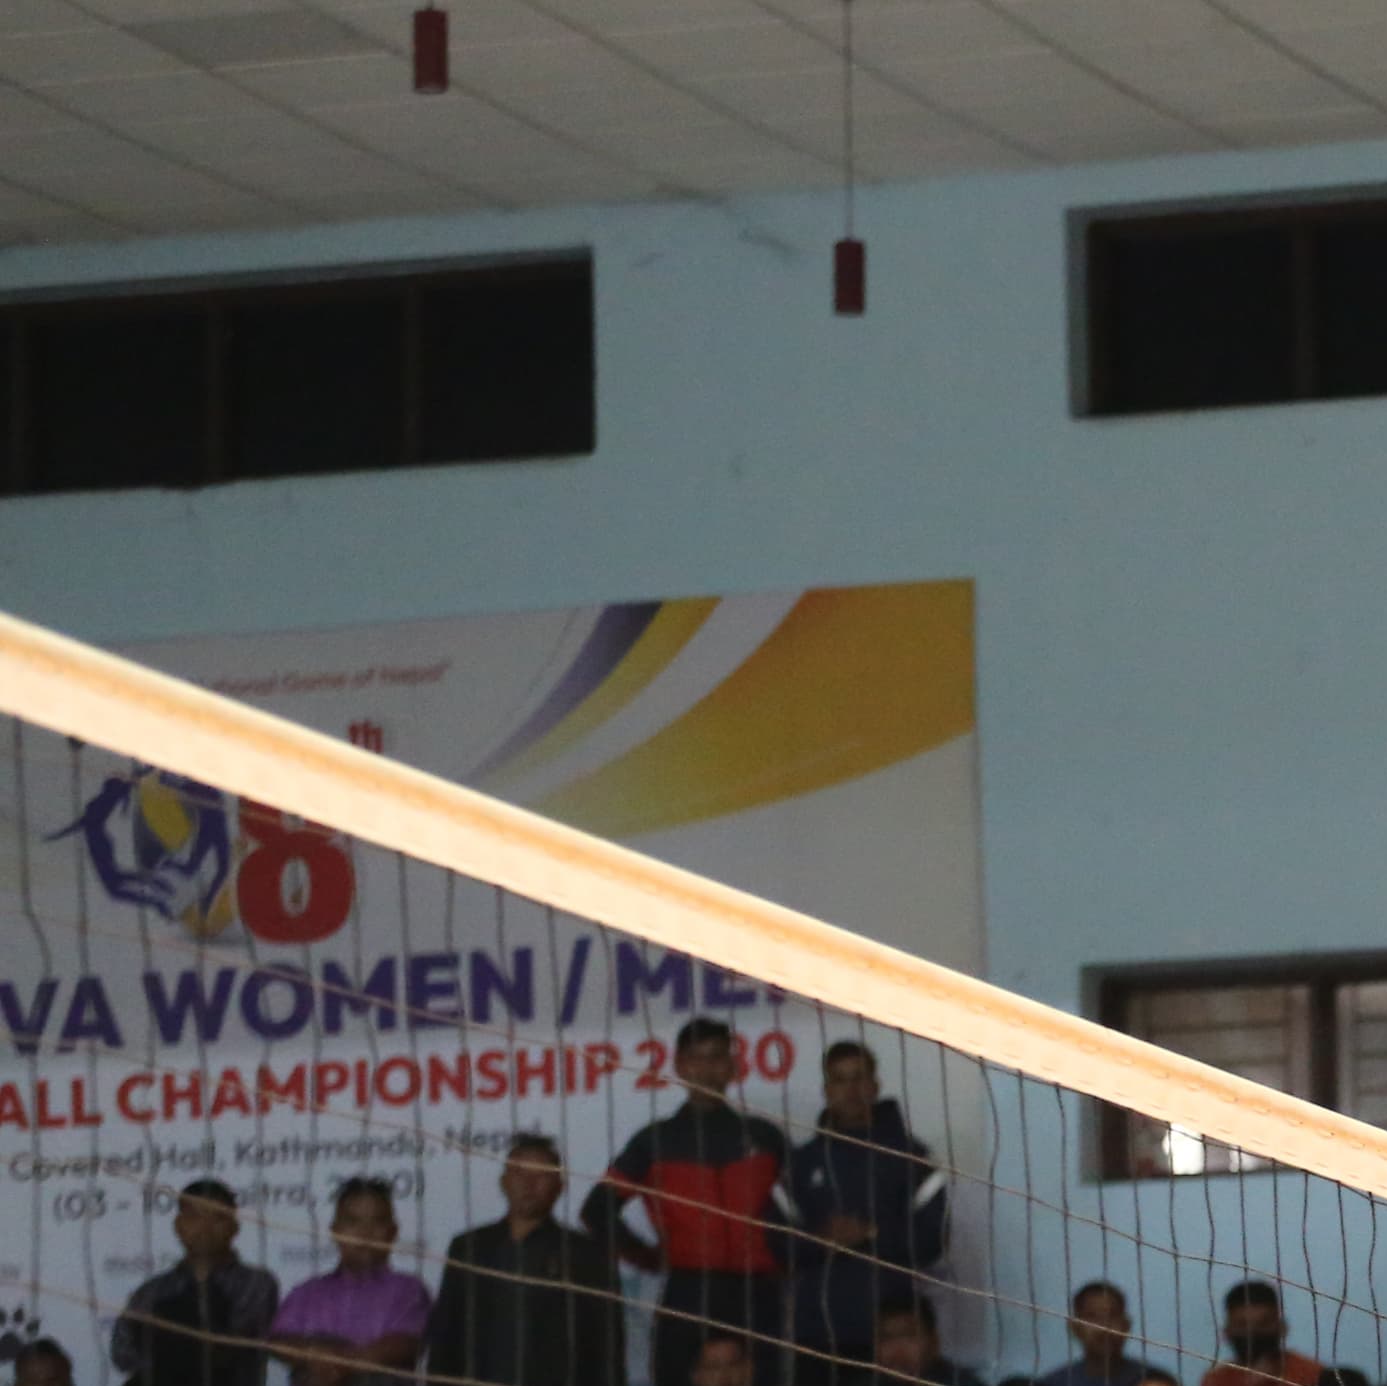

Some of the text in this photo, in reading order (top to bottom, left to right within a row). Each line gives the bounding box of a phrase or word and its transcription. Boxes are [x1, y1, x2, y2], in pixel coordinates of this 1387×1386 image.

[142, 945, 536, 1045] WOMEN
[615, 940, 788, 1015] ME
[117, 1042, 621, 1124] CHAMPIONSHIP
[634, 1029, 796, 1091] 20
